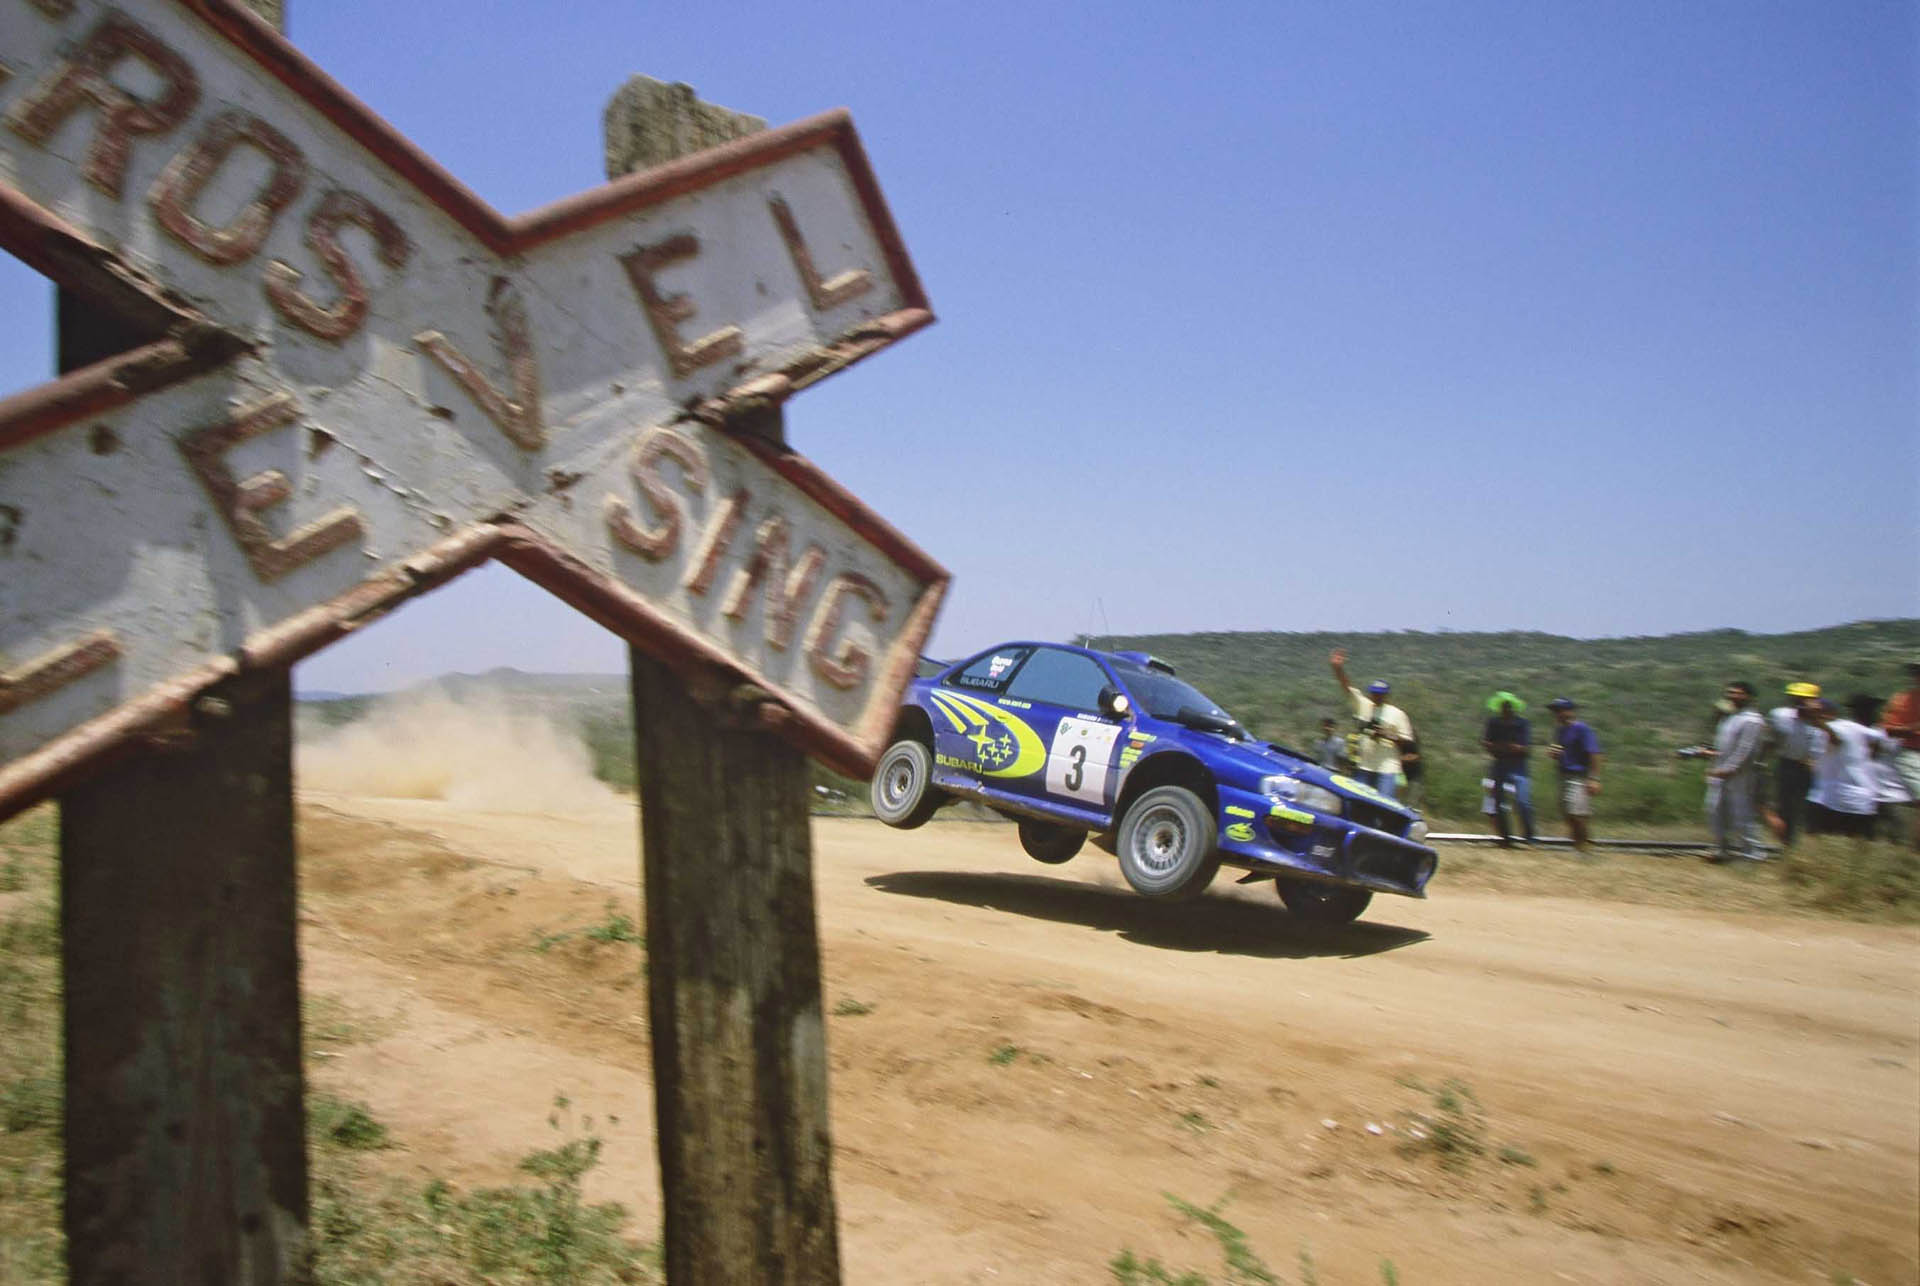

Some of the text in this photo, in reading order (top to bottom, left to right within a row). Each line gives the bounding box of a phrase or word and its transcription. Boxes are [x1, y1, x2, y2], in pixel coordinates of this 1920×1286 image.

[0, 0, 889, 690] ROSSING
[936, 752, 983, 774] SUBARU
[1065, 744, 1087, 792] 3
